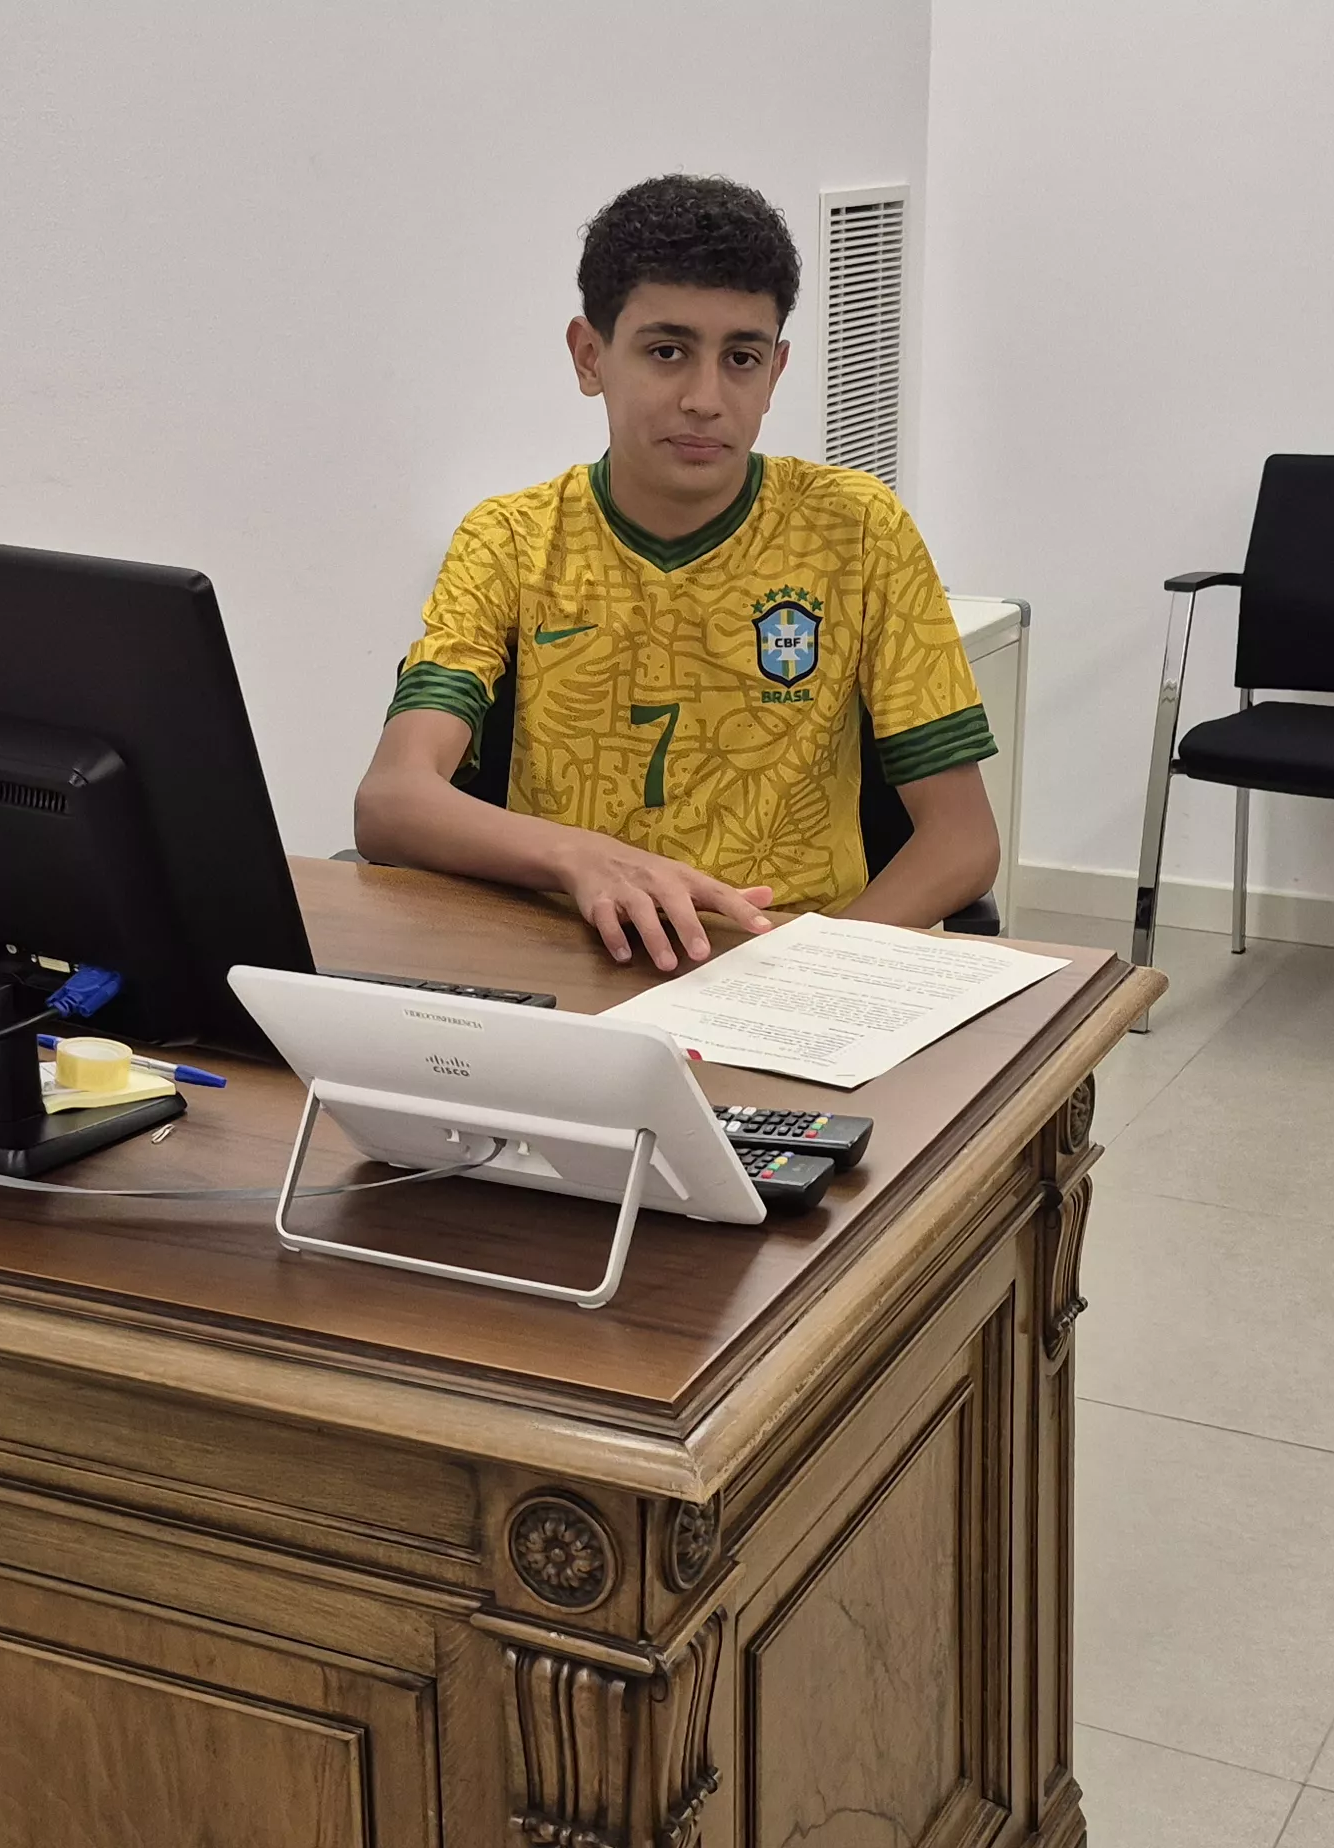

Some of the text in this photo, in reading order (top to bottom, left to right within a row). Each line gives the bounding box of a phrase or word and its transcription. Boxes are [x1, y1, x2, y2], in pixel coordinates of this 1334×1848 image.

[775, 637, 801, 648] CBF
[761, 689, 814, 703] BRASIL
[630, 702, 680, 808] 7
[404, 1009, 482, 1029] VIDEOCONFERENCIA
